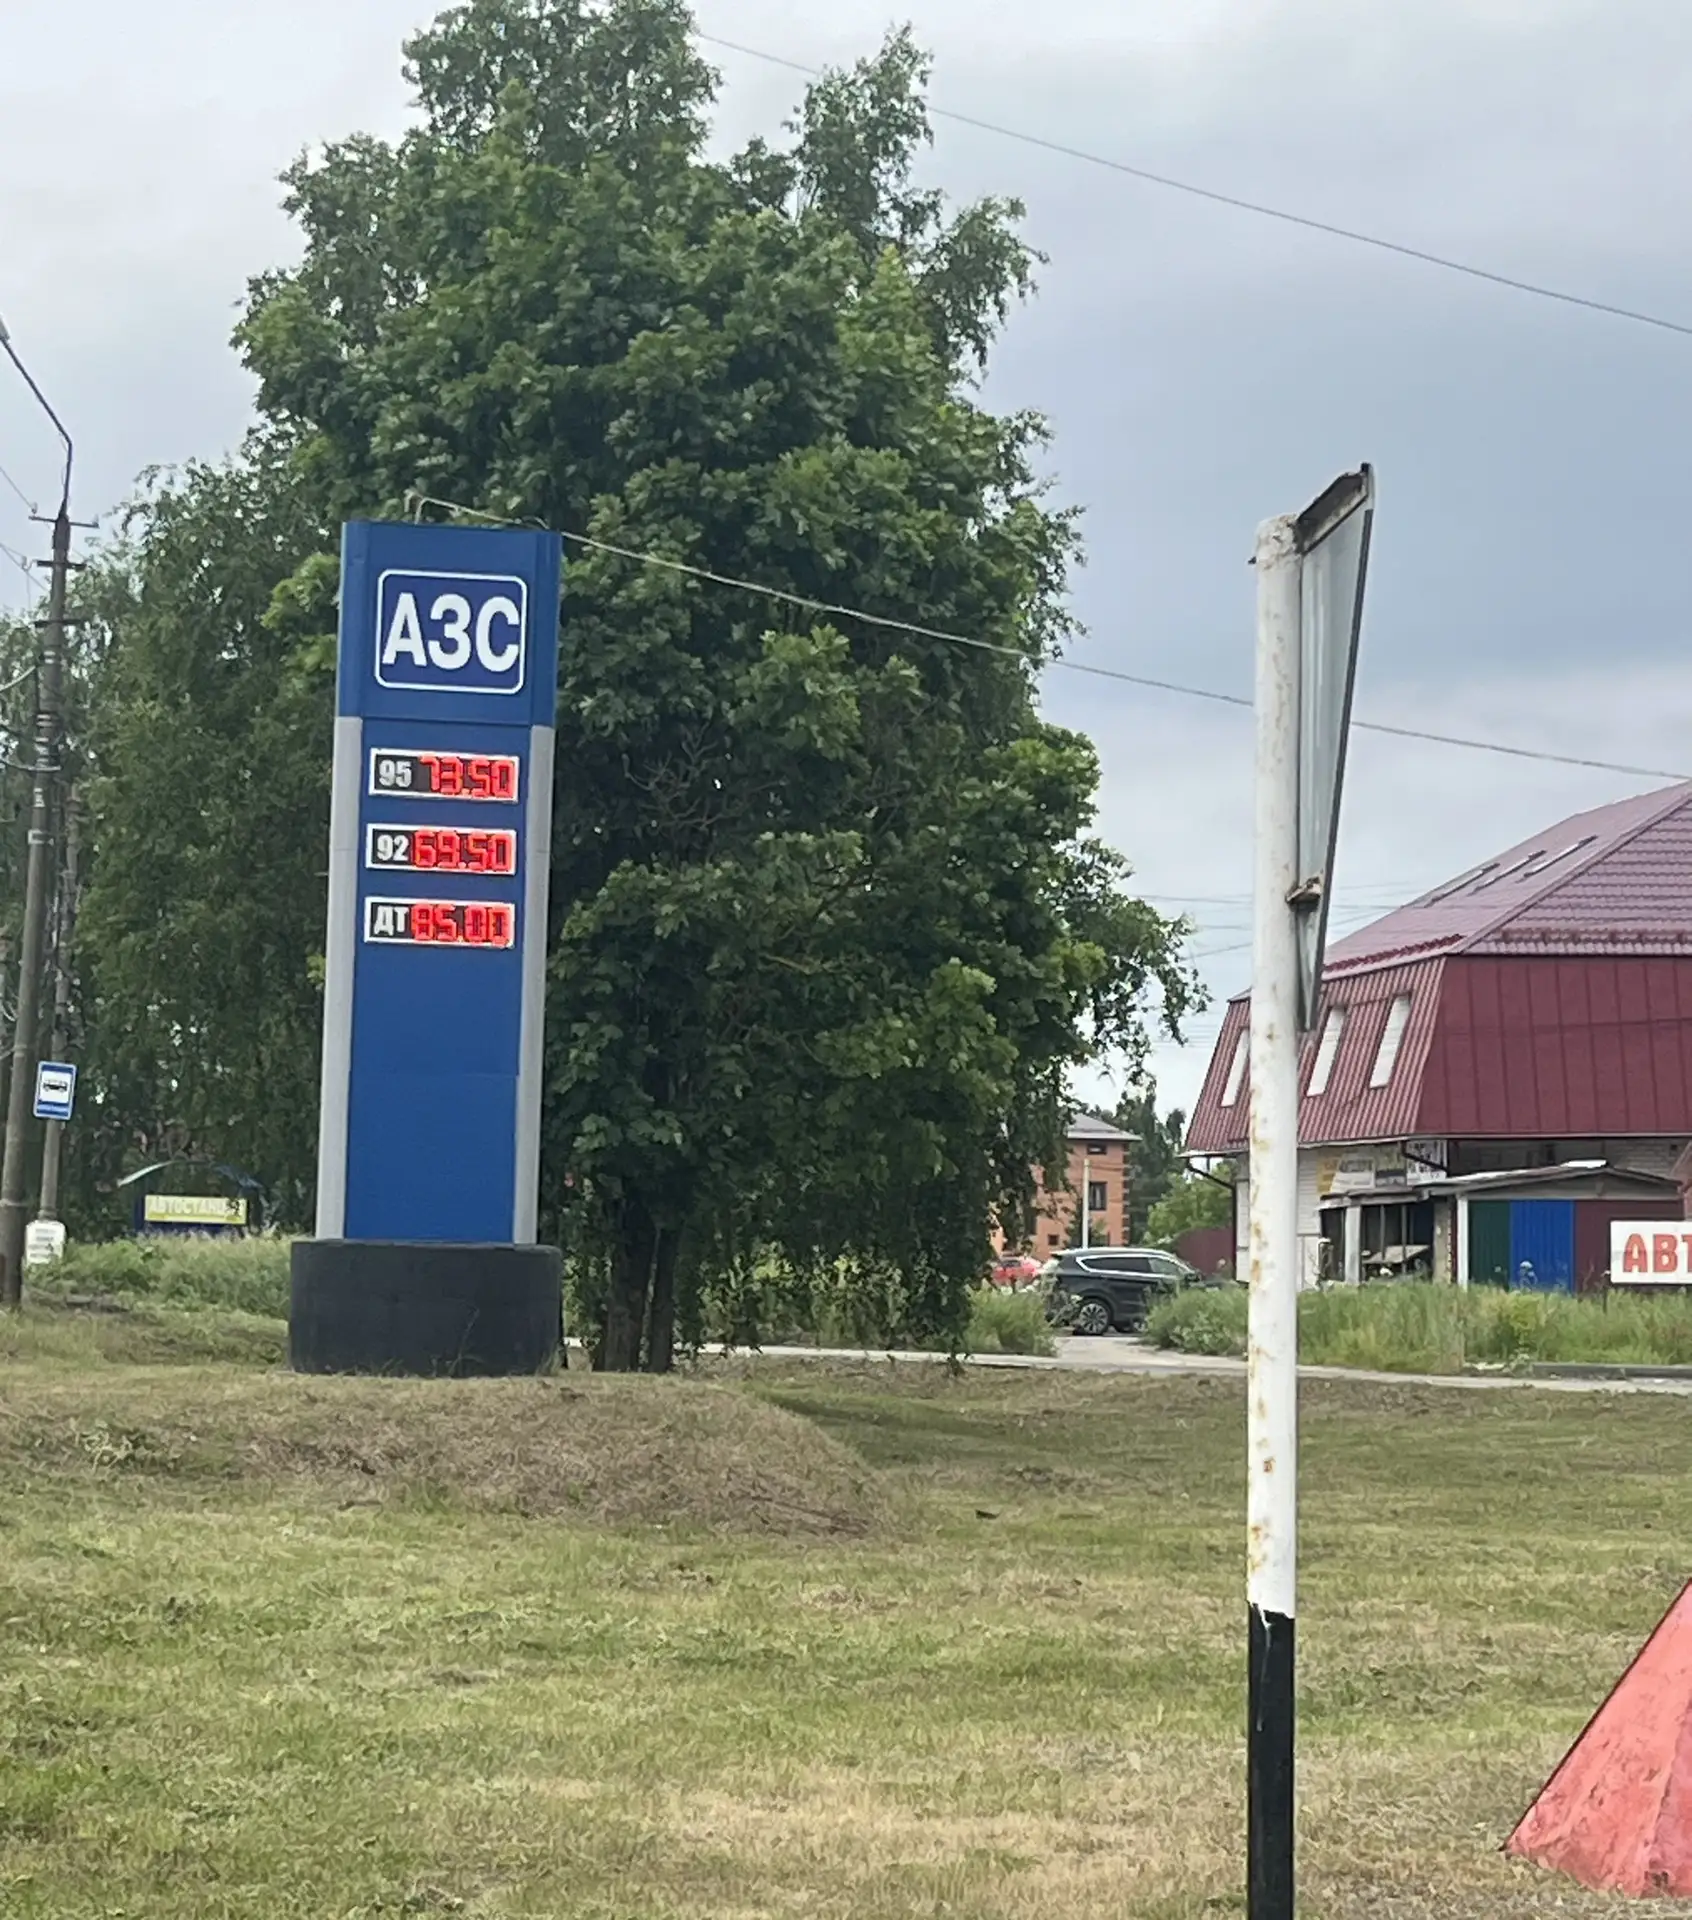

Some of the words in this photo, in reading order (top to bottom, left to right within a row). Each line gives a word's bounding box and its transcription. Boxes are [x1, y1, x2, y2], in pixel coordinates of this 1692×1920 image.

[382, 592, 520, 672] АЗС
[379, 760, 412, 787] 95
[419, 755, 515, 798] 73.50
[376, 835, 409, 861] 92
[413, 829, 513, 872] 69.50
[373, 906, 409, 936] ДТ
[410, 903, 510, 947] 85.00
